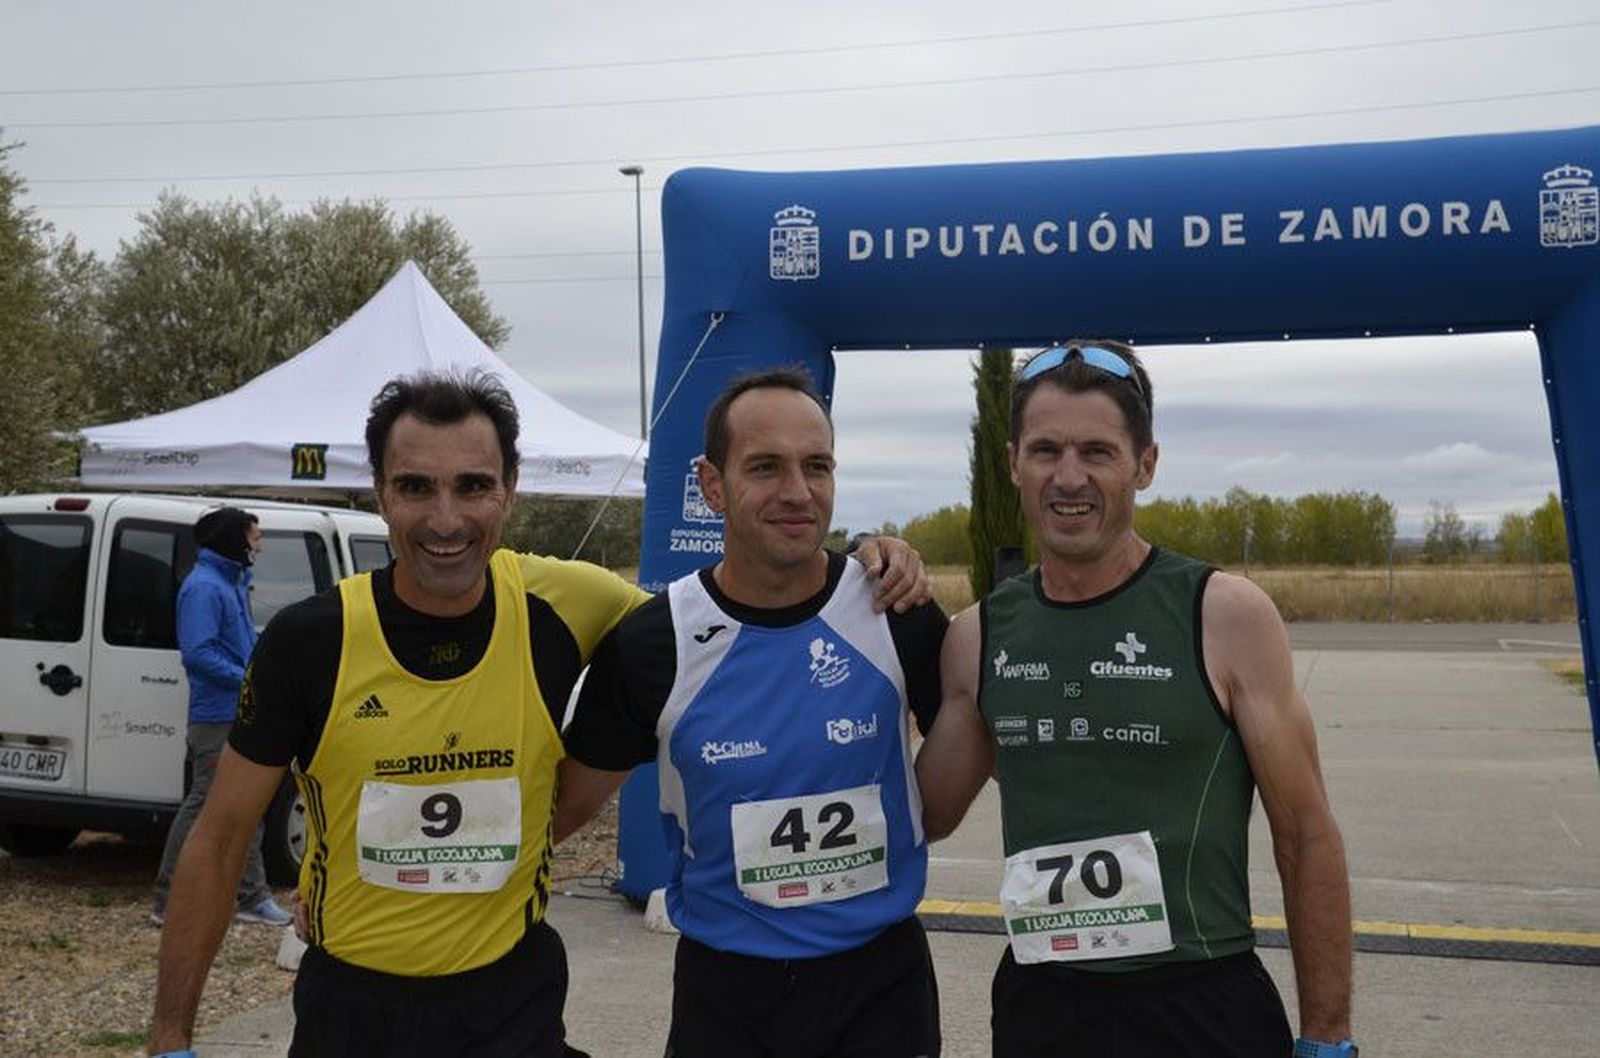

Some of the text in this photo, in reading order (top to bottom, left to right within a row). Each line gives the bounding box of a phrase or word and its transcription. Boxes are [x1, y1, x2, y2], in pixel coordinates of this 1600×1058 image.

[848, 200, 1511, 261] DIPUTACIÓN DE ZAMORA
[670, 528, 722, 540] DIPUTACIÓN
[669, 538, 725, 554] ZAMOR
[1090, 660, 1173, 678] Cifuentes
[354, 708, 388, 718] adidas
[1102, 725, 1160, 744] canal
[0, 751, 21, 769] 40
[375, 750, 514, 774] SOLO RUNNERS
[420, 793, 462, 838] 9
[770, 801, 857, 853] 42
[1036, 849, 1123, 905] 70
